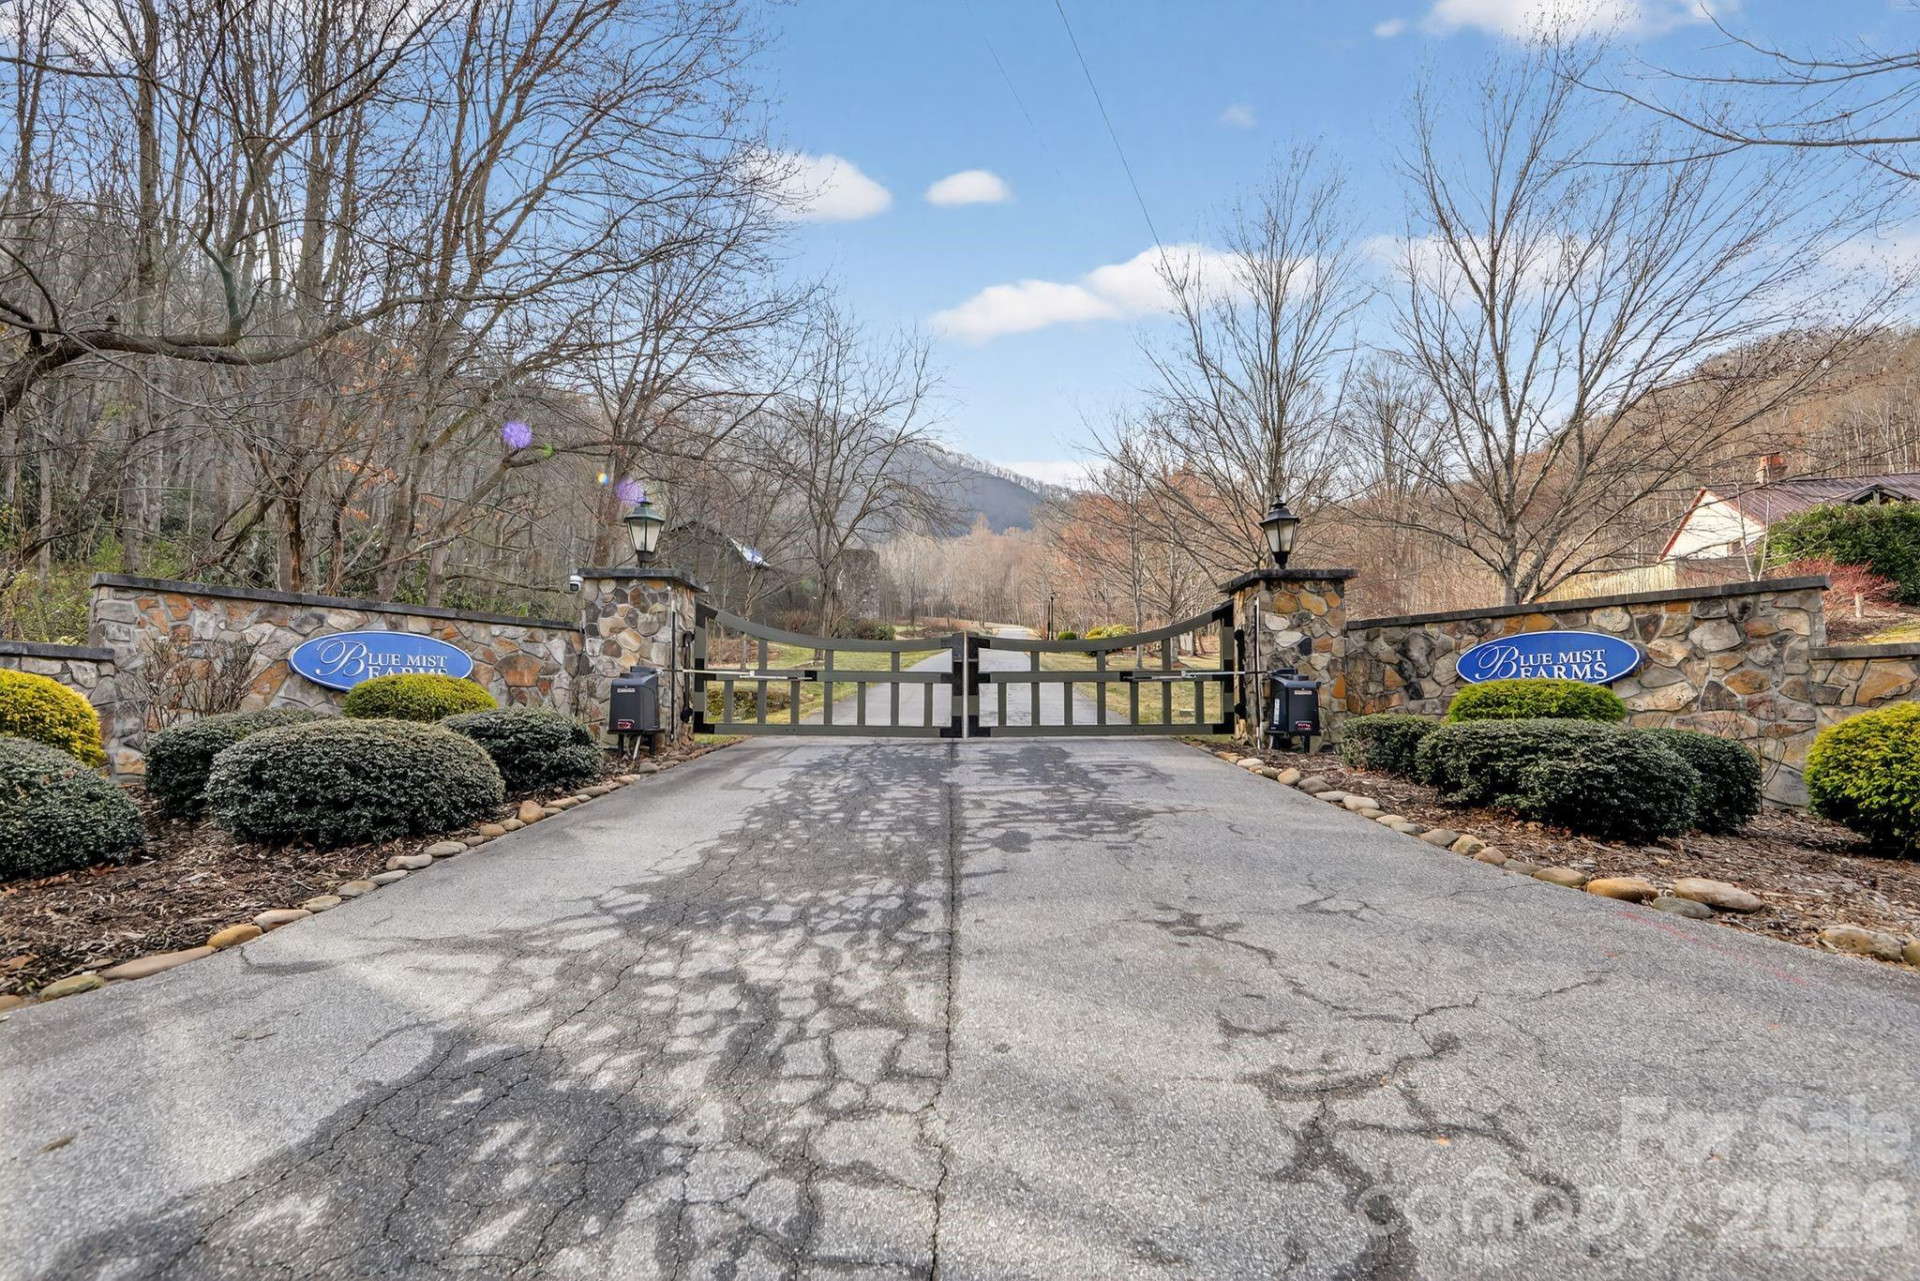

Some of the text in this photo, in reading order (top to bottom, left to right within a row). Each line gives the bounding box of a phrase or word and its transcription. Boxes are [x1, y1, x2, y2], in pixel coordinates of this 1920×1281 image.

[315, 638, 448, 677] BLUE MIST
[1475, 645, 1606, 680] BLUE MIST
[1520, 662, 1608, 680] FARMS
